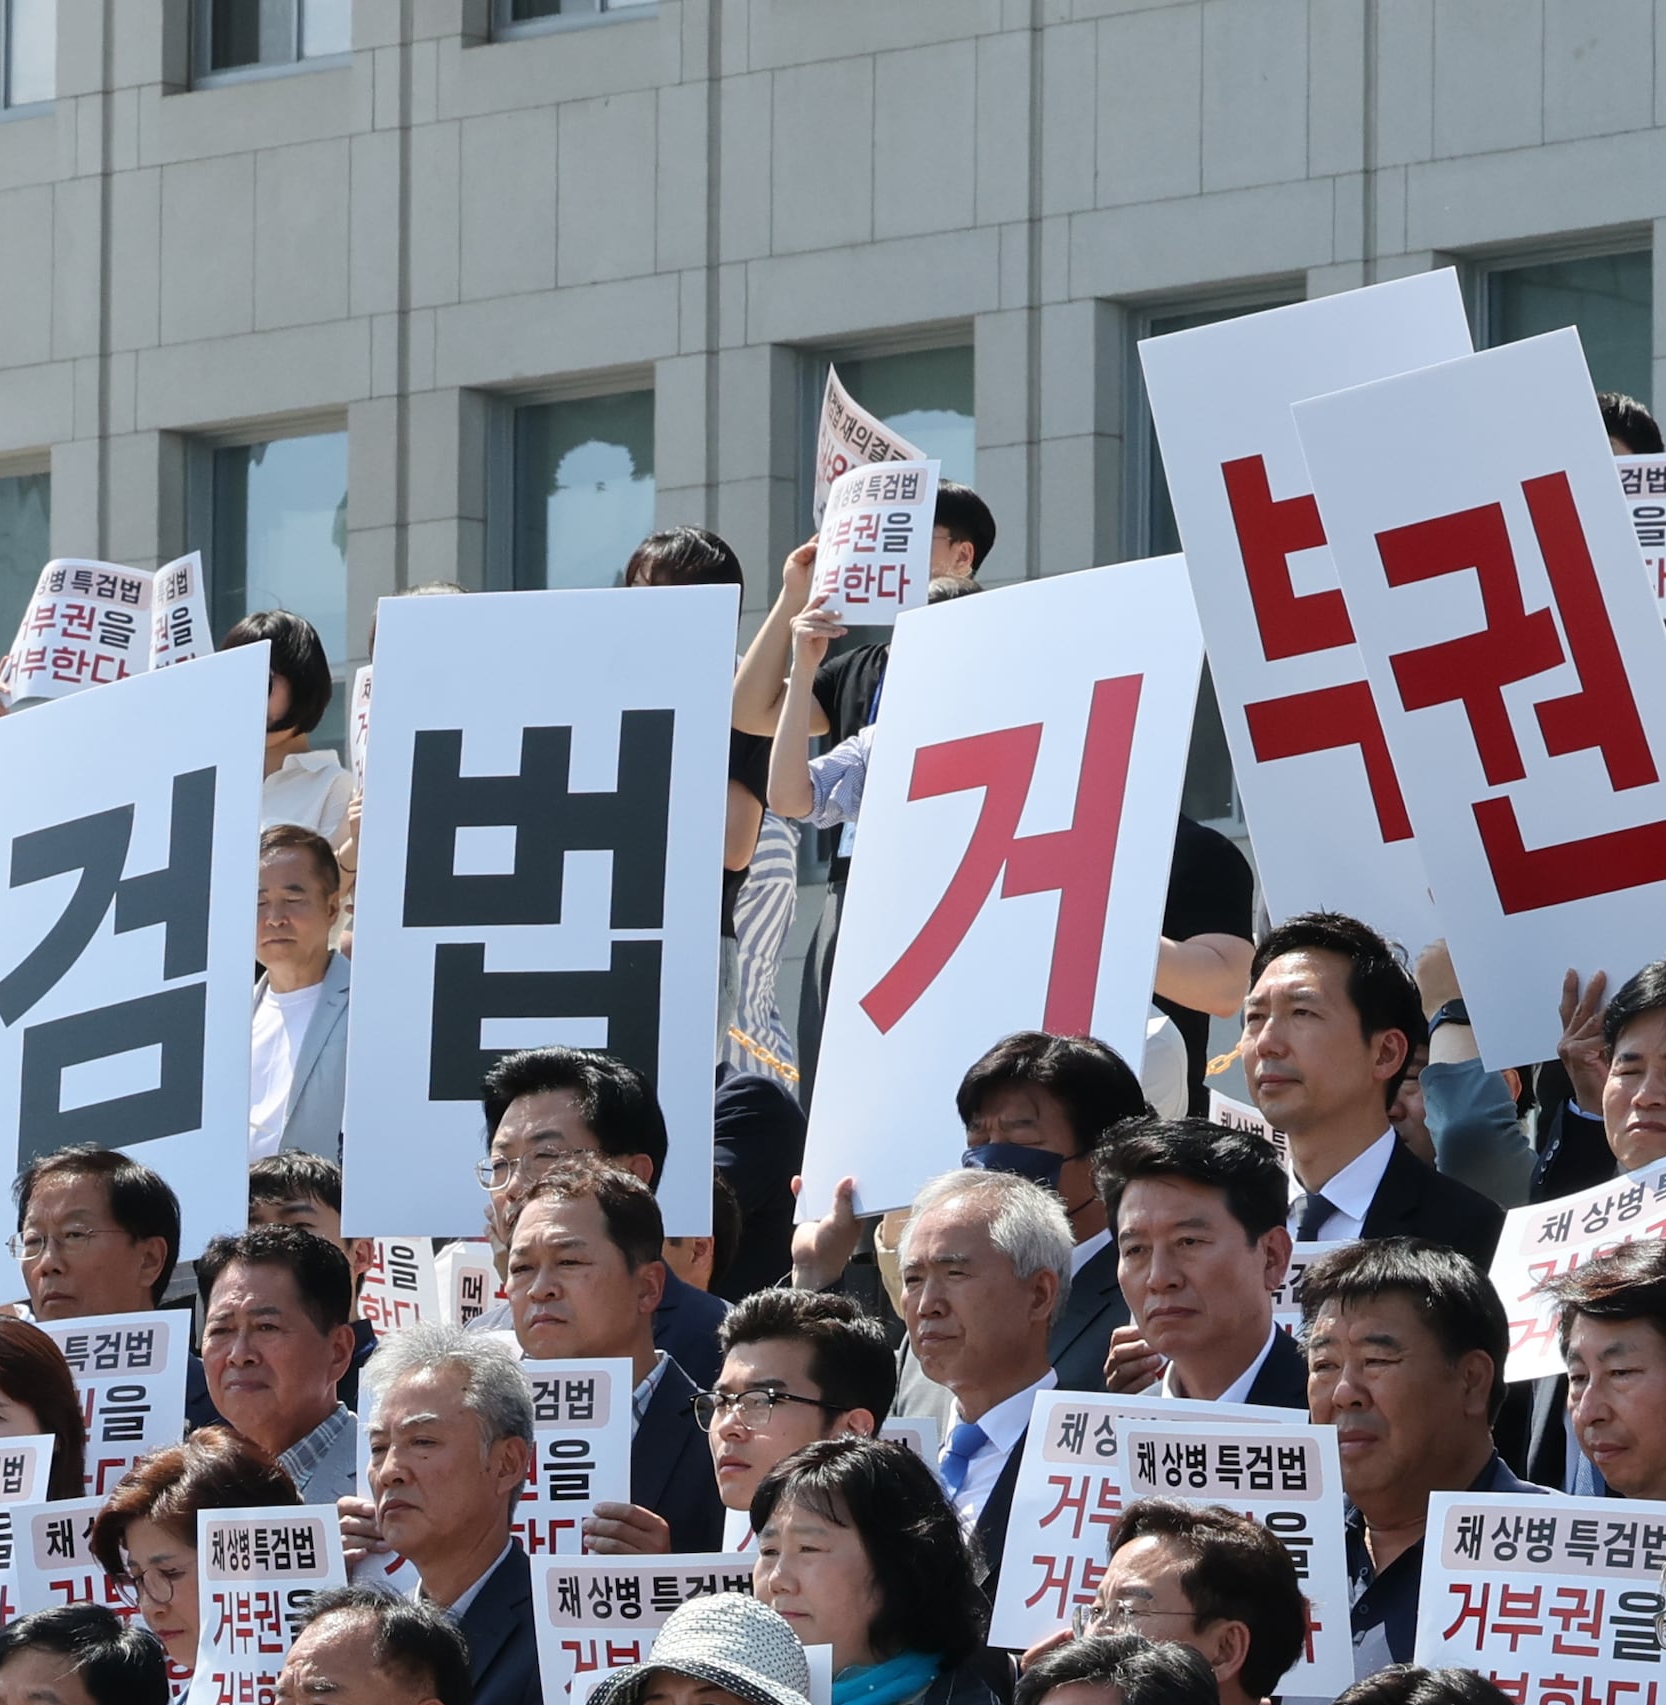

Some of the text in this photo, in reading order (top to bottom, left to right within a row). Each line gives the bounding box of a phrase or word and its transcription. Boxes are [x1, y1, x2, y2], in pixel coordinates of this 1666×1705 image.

[865, 473, 919, 500] 특검법
[71, 570, 142, 604] 특검법
[858, 672, 1144, 1038] 거
[402, 709, 676, 1101] 법
[1538, 1210, 1571, 1244] 채
[1581, 1180, 1646, 1234] 상병
[65, 1327, 155, 1373] 특검법
[1137, 1442, 1308, 1490] 채 상병 특검법
[228, 1525, 316, 1571] 상병 특검법
[1454, 1515, 1482, 1561] 채
[1490, 1520, 1556, 1564] 상병
[1443, 1582, 1663, 1664] 거부권을
